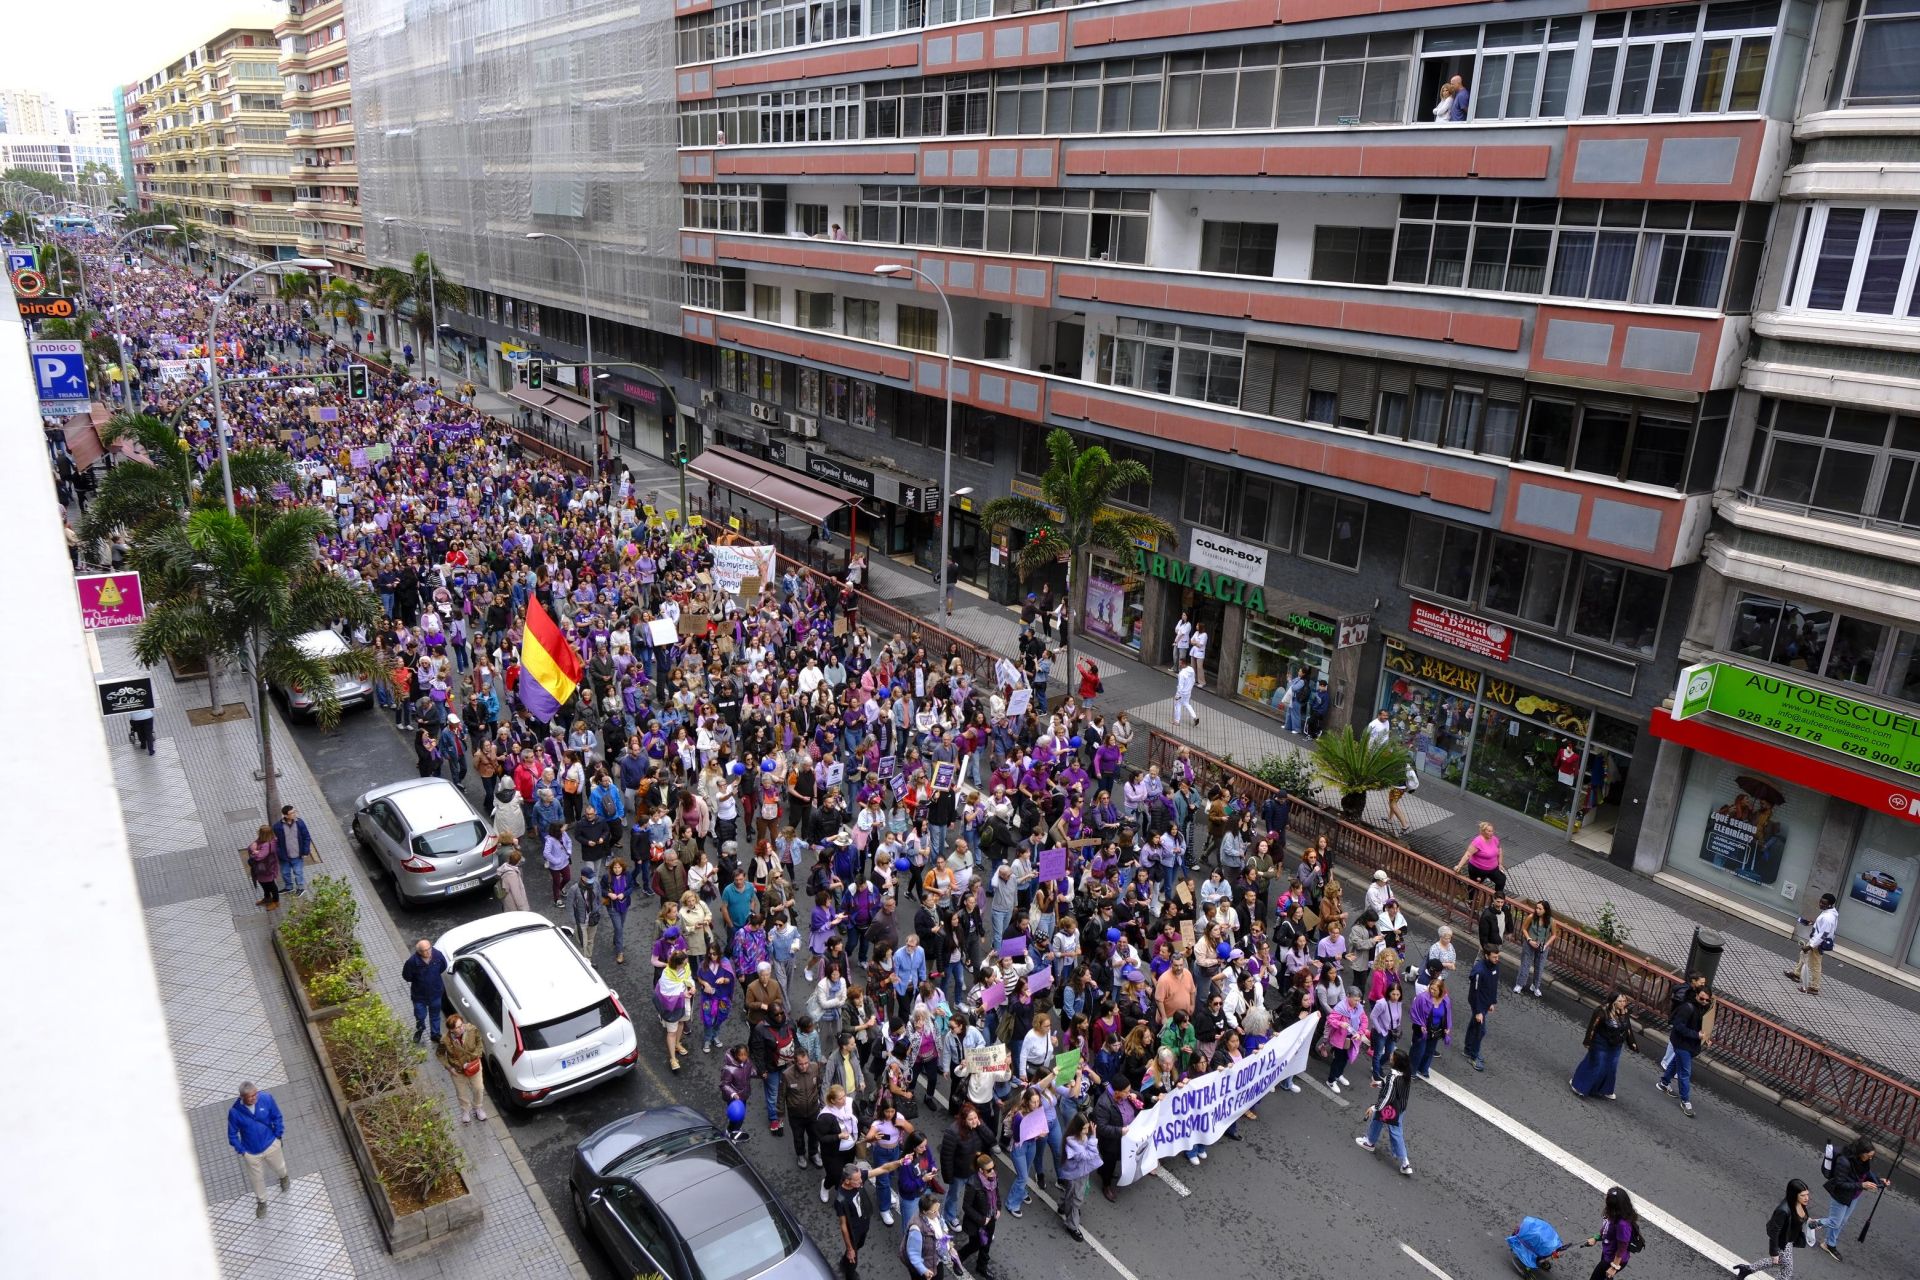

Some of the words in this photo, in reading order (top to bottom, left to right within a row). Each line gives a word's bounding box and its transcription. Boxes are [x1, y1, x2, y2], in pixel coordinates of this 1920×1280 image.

[20, 301, 70, 316] bingu
[36, 344, 77, 352] INDIGO
[38, 358, 67, 388] P
[41, 406, 78, 414] CLIMATE
[1196, 538, 1263, 565] COLOR-BOX
[726, 562, 753, 571] mujeres
[1135, 549, 1265, 613] ARMACIA
[84, 611, 143, 628] Watermelon
[1288, 614, 1334, 636] HOMEOPAT
[1440, 608, 1486, 629] Anyma
[1448, 618, 1487, 637] Dental
[1422, 656, 1478, 694] BAZAR
[1778, 710, 1890, 748] info@autoescuelaseco.com
[1781, 701, 1892, 739] www.autoescuelaseco.com
[1738, 708, 1761, 723] 928
[1763, 716, 1782, 729] 38
[1785, 723, 1801, 735] 21
[1806, 729, 1823, 742] 78
[1841, 741, 1868, 756] 628
[1871, 749, 1899, 766] 900
[1710, 811, 1729, 824] ¿QUÉ
[1730, 818, 1757, 834] SEGURO
[1713, 823, 1754, 843] ELEGIRÍAS?
[1711, 845, 1730, 855] SALUD
[1171, 1081, 1217, 1116] CONTRA
[1219, 1075, 1231, 1097] EL
[1235, 1061, 1258, 1091] ODIO
[1259, 1055, 1266, 1076] Y
[1267, 1049, 1276, 1071] EL
[1153, 1111, 1210, 1151] FASCISMO
